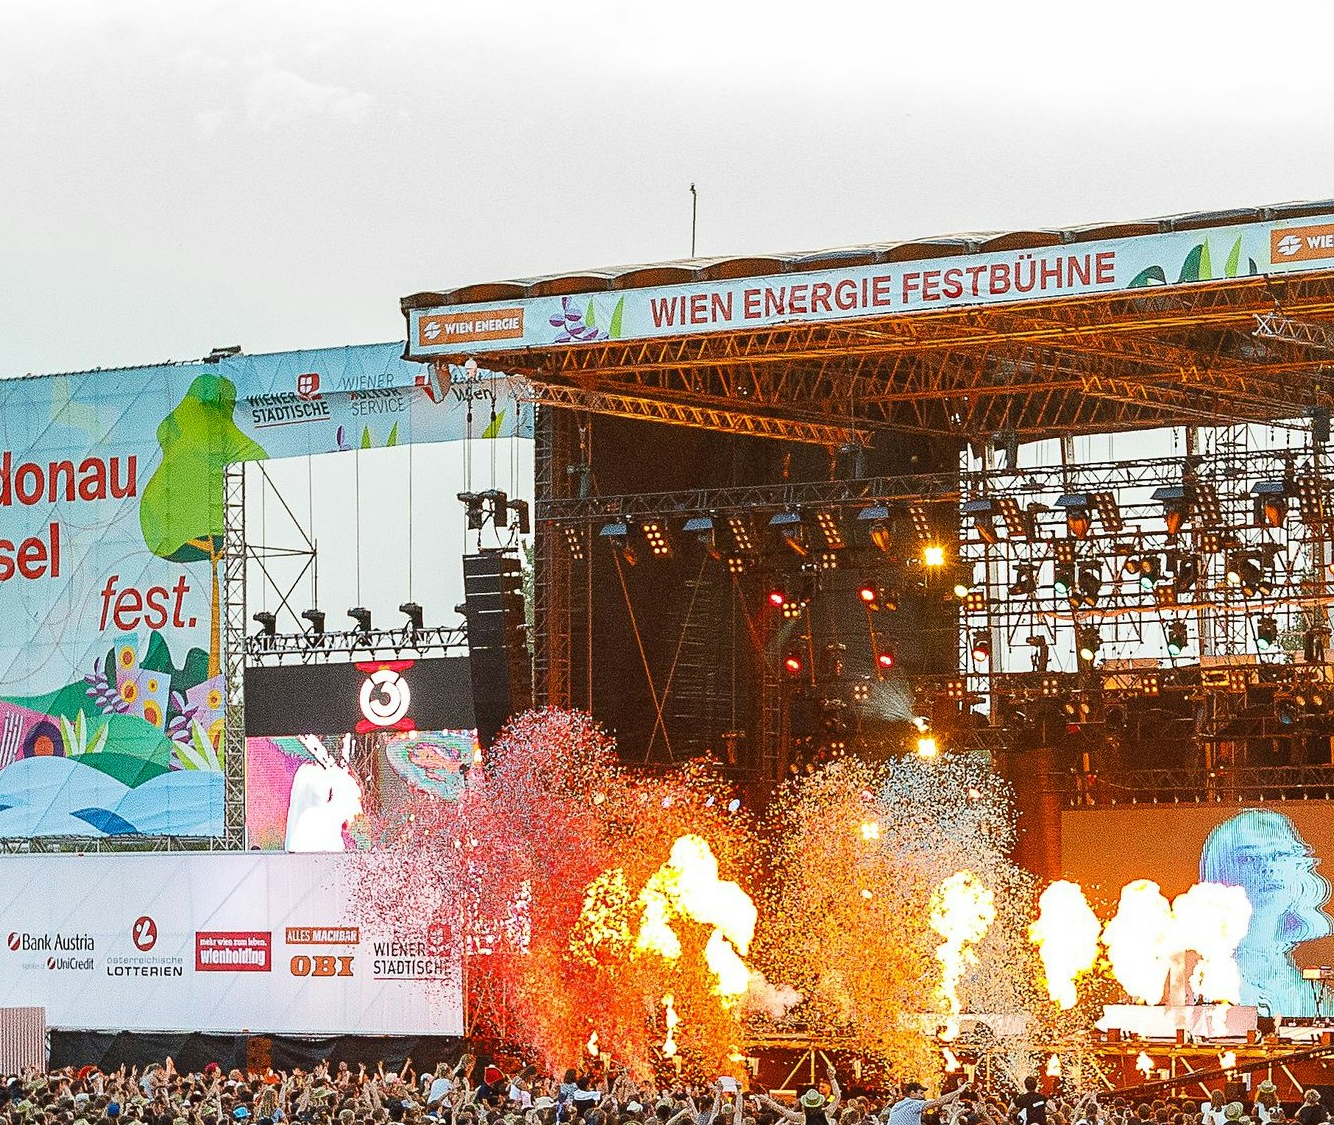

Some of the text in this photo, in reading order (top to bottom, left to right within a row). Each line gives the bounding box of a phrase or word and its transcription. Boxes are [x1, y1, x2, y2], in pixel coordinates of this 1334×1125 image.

[650, 251, 1116, 329] WIEN ENERGIE FESTBÜHNE
[445, 316, 519, 335] WIEN ENERGIE
[340, 373, 394, 390] WIENER
[252, 401, 330, 424] STÄDTISCHE
[351, 397, 405, 416] SERVICE
[99, 574, 199, 632] fest.
[22, 933, 94, 951] Bank Austria
[287, 929, 357, 942] ALLES MACHBAR
[374, 942, 425, 957] WIENER
[57, 957, 94, 970] UniCredit
[107, 967, 183, 976] LOTTERIEN
[290, 955, 355, 977] OBI
